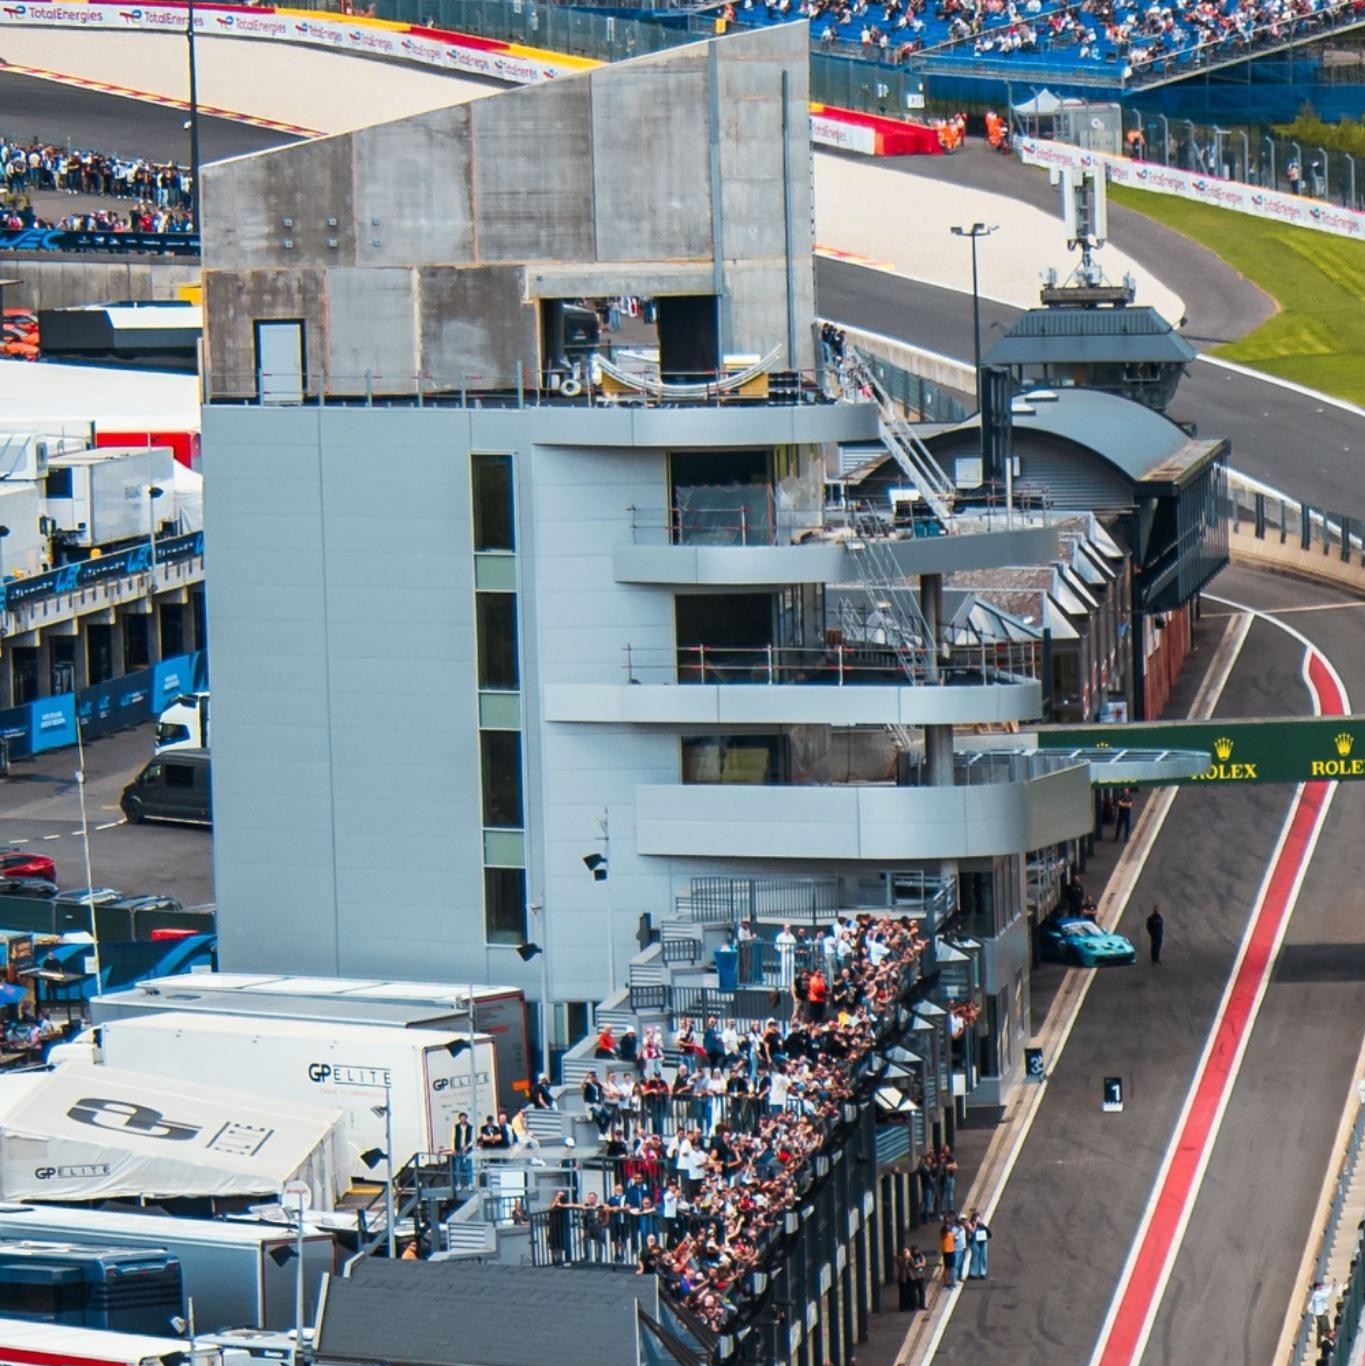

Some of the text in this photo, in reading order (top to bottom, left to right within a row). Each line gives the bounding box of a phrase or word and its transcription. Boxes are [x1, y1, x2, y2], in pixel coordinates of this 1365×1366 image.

[28, 6, 104, 24] TotalEnergies
[235, 17, 287, 36] TotalEnergies
[308, 1063, 392, 1085] GP ELITE
[432, 1078, 449, 1091] GP
[1111, 1084, 1121, 1102] 1
[35, 1167, 56, 1179] GP
